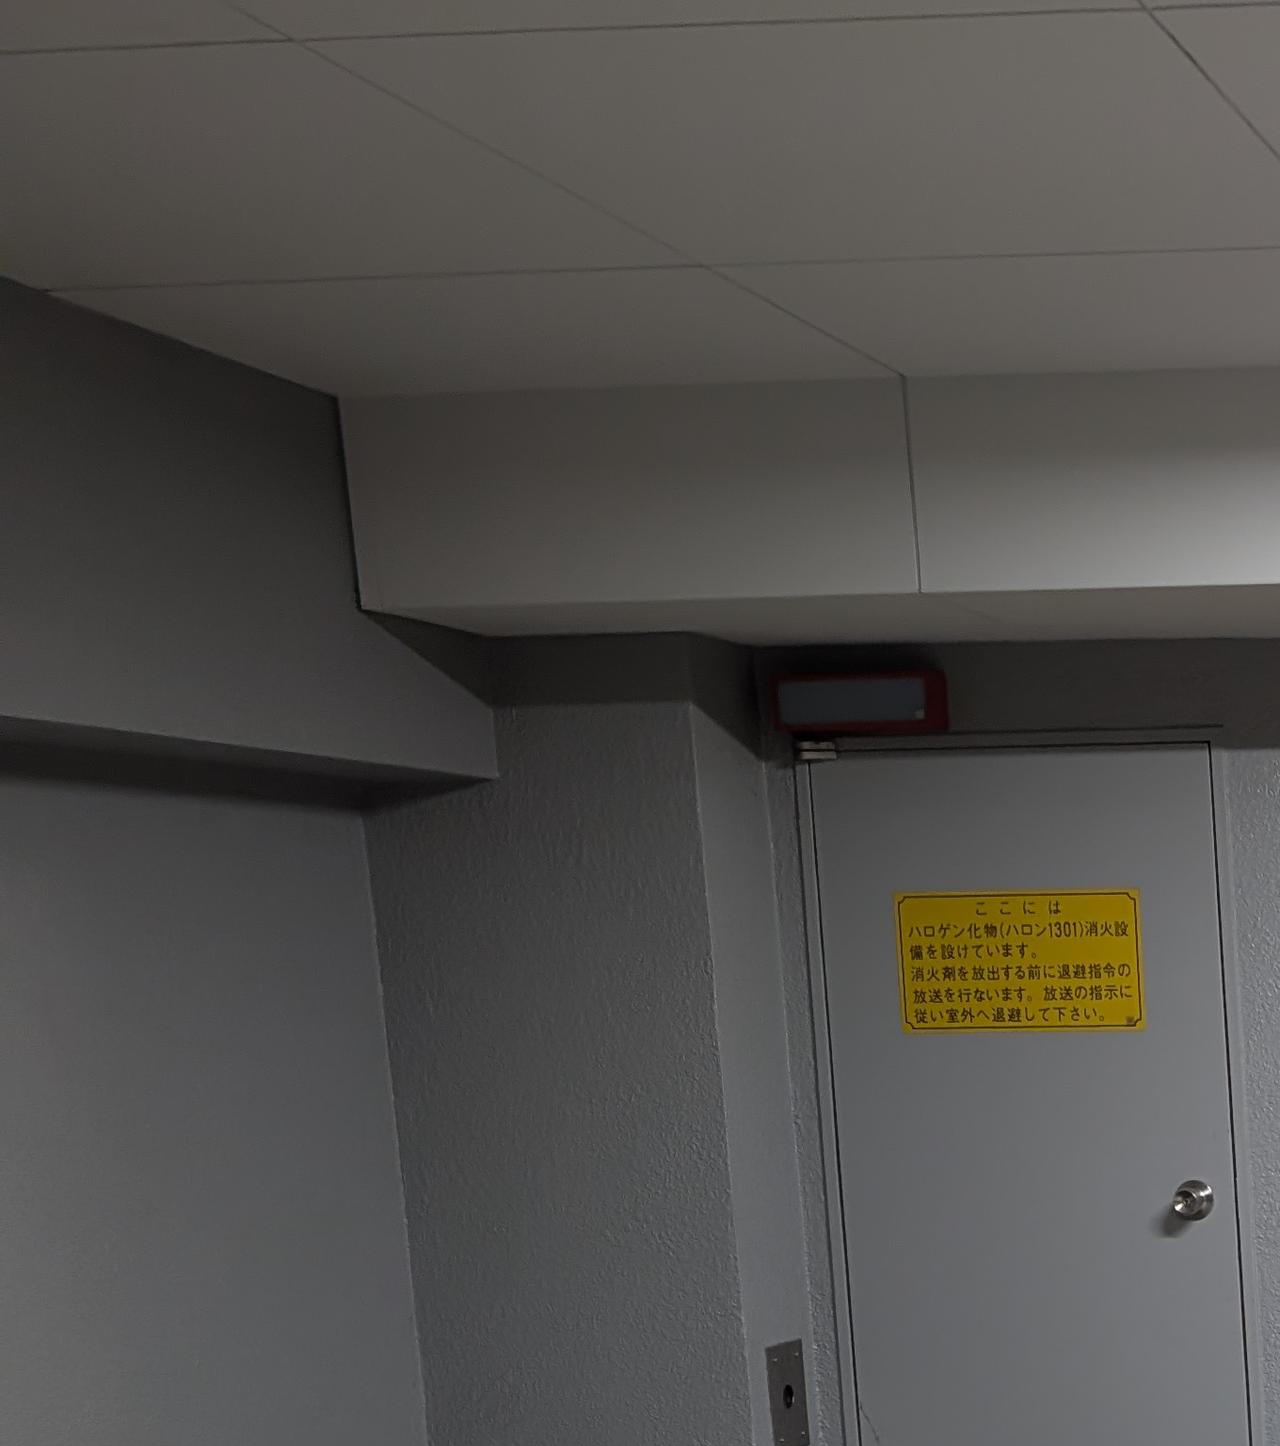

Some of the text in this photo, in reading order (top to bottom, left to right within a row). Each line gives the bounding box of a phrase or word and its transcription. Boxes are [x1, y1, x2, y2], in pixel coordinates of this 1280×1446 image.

[975, 900, 1062, 915] ここには
[908, 921, 1129, 939] ハロゲン化物(ハロン1301)消火設
[909, 943, 1037, 960] 備を設けています。
[910, 962, 1131, 982] 消火剤を放出する前に退避指令の
[913, 1006, 1105, 1024] 従い室外へ退避して下さい。
